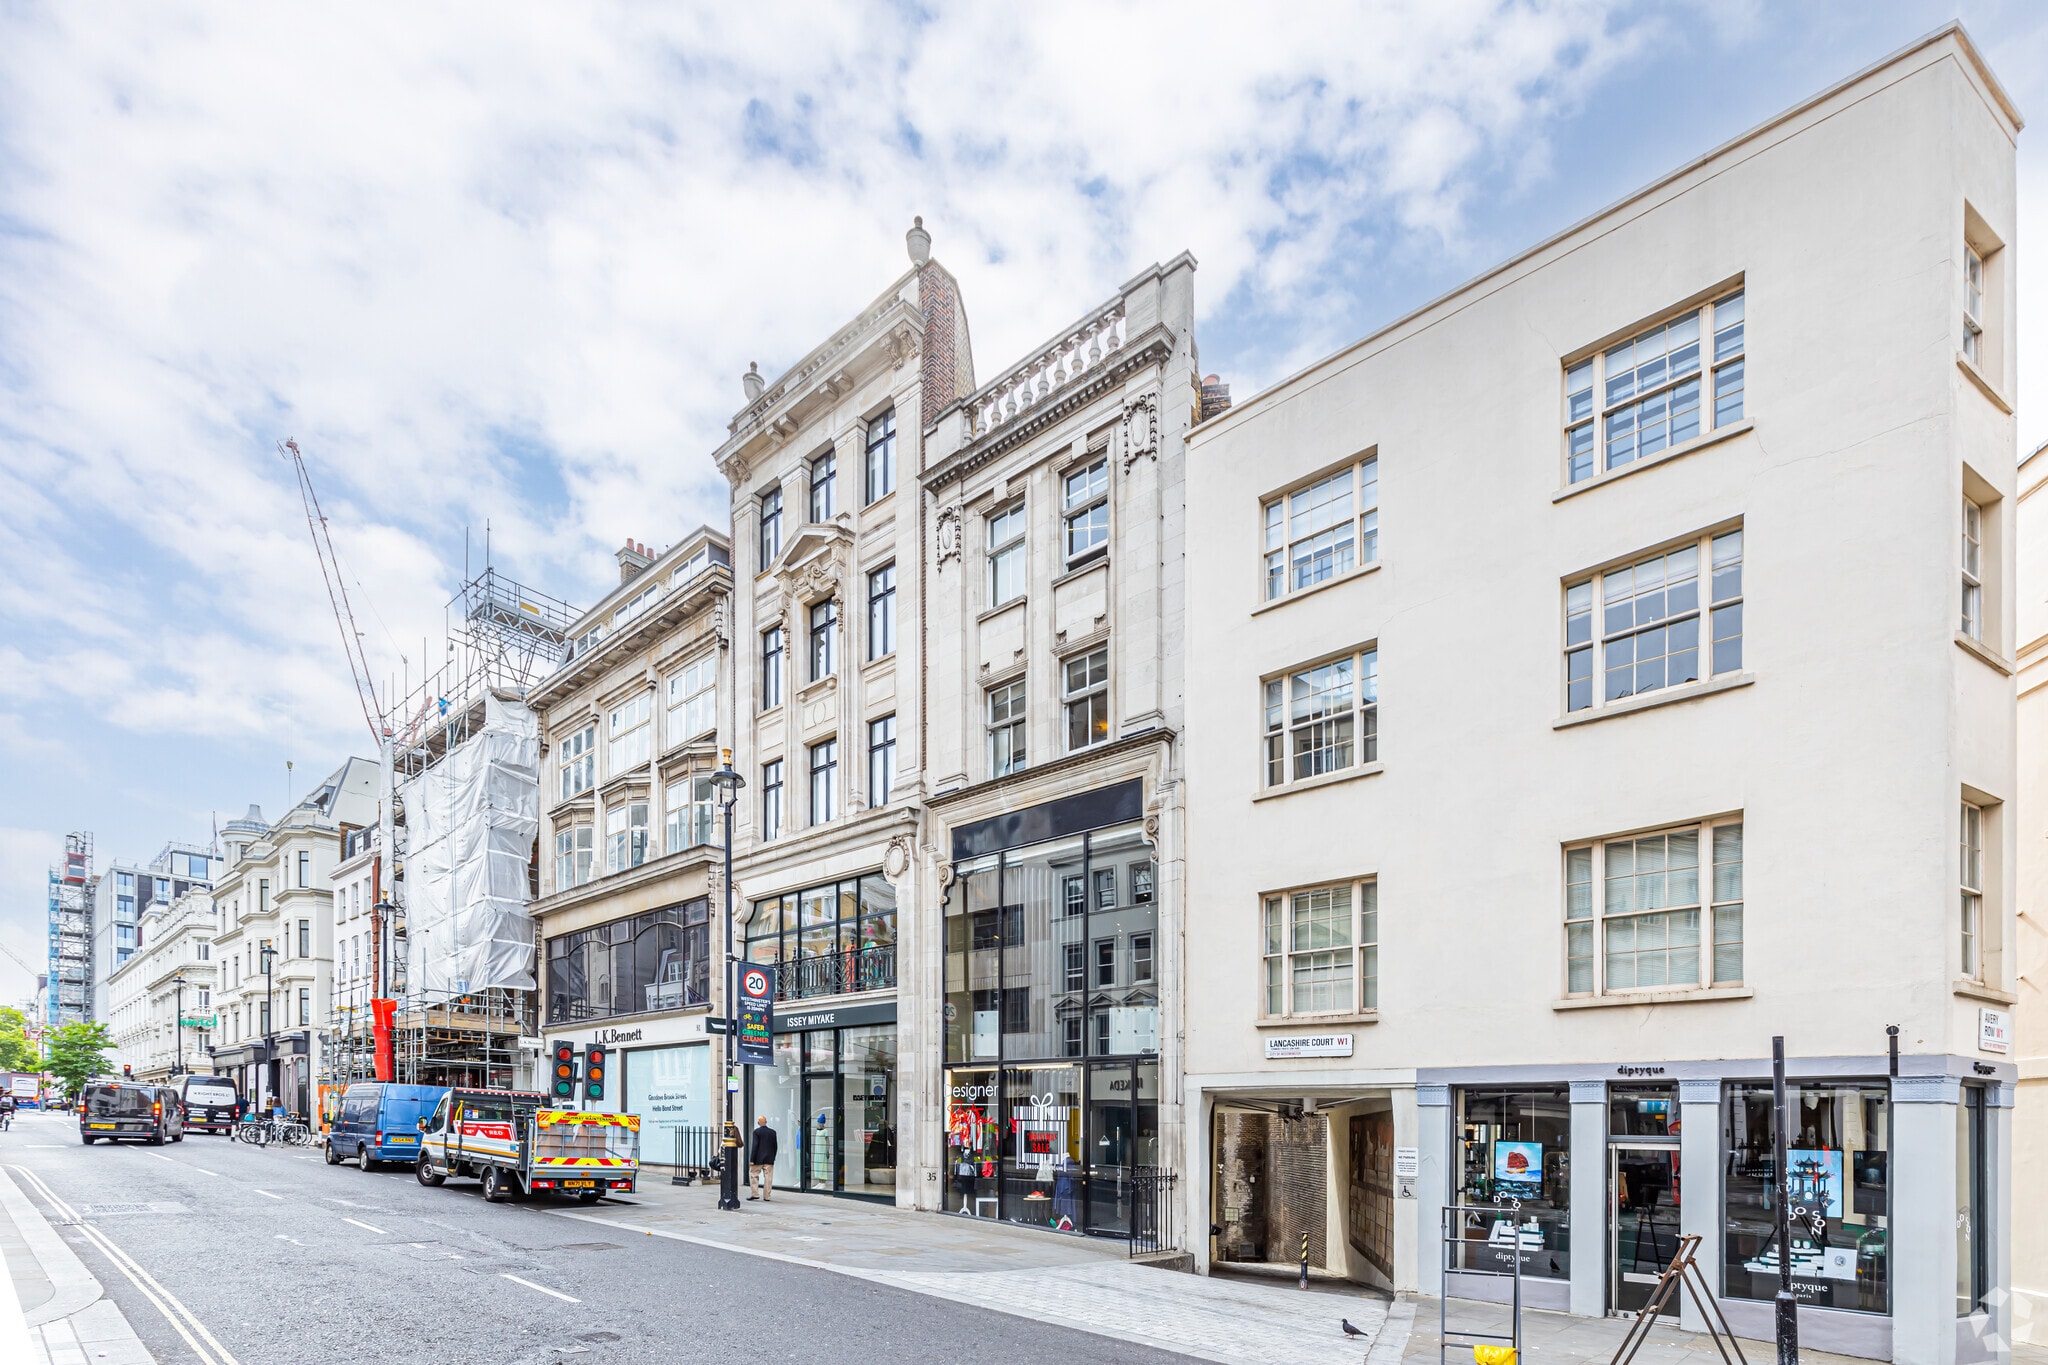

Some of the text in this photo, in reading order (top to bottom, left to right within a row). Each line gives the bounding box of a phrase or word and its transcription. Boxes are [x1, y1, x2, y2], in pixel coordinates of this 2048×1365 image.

[748, 977, 764, 990] 20
[787, 1014, 835, 1028] ISSEY MIYAKE
[1984, 1013, 1999, 1024] AVERY
[742, 1029, 769, 1037] GREENER
[1985, 1026, 2003, 1038] ROW W1
[742, 1035, 769, 1043] CLEANER
[1270, 1038, 1348, 1048] LANCASHIRE COURT W1
[1617, 1065, 1665, 1077] diptyque
[1032, 1143, 1050, 1153] SALE
[926, 1172, 937, 1181] 35
[1496, 1252, 1531, 1264] diptyue
[1791, 1282, 1828, 1294] ptyque
